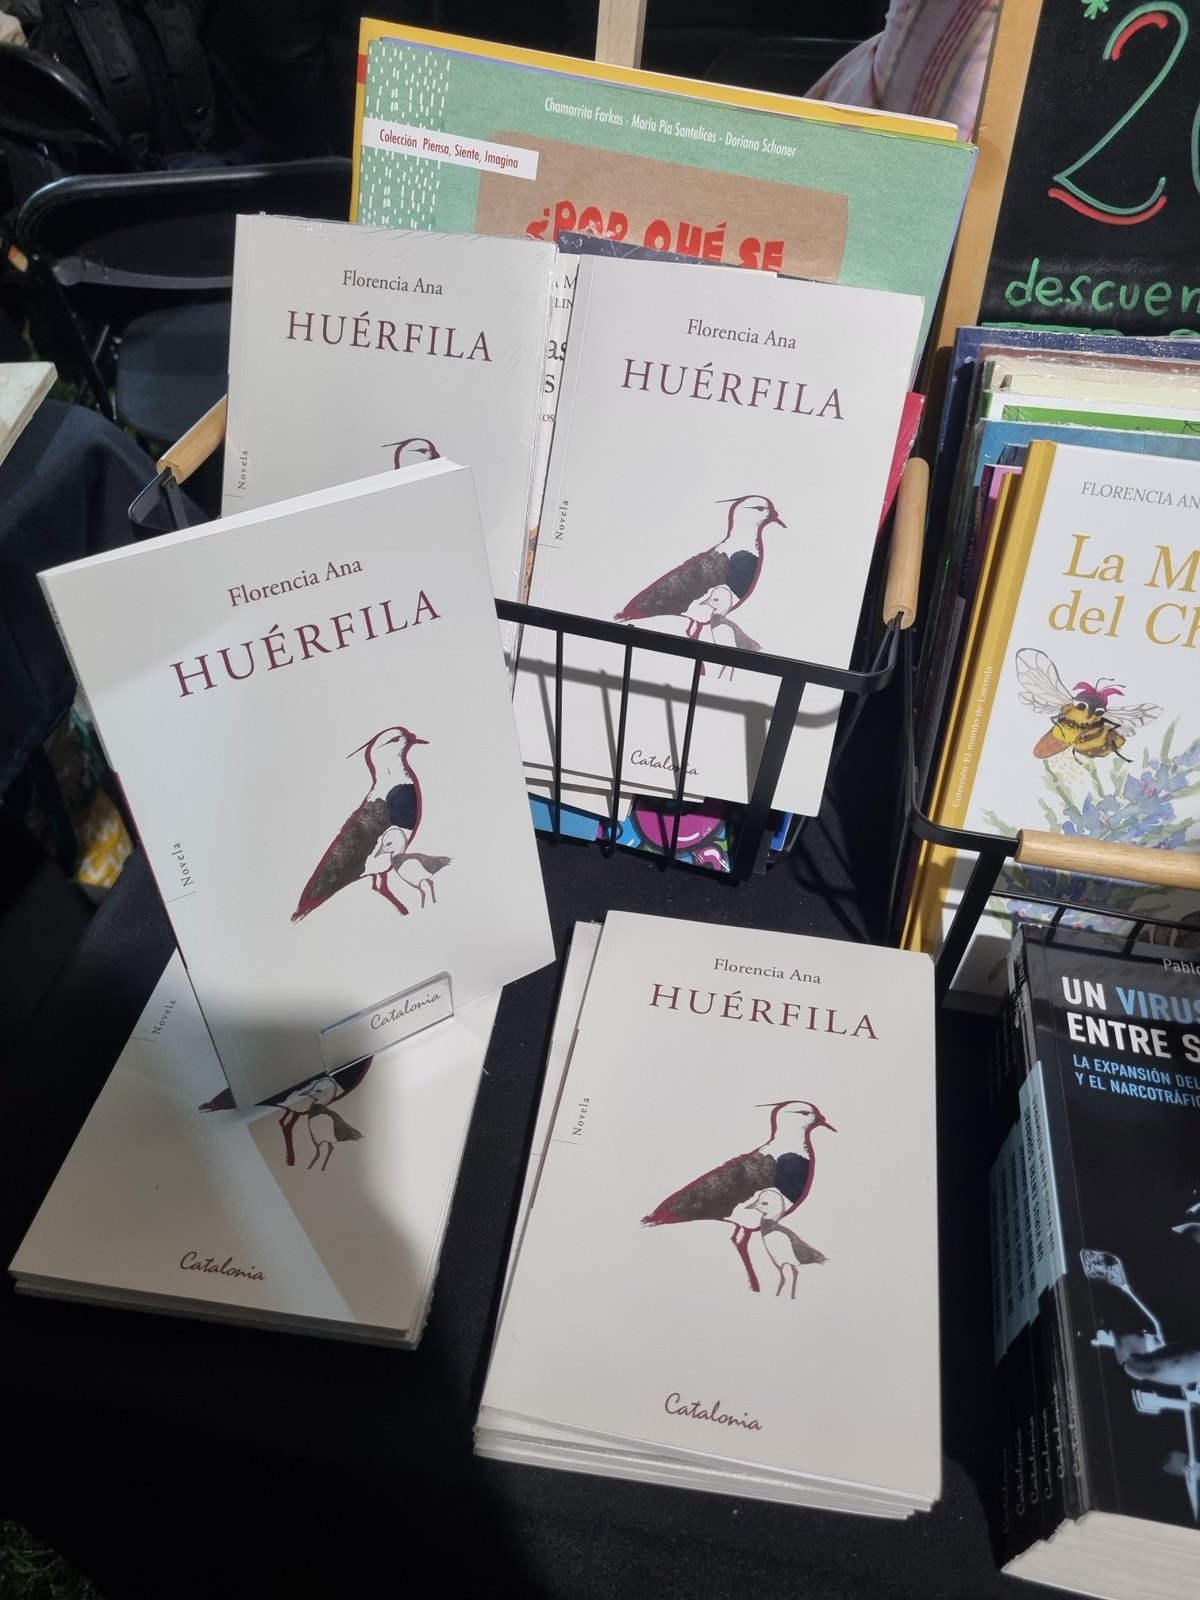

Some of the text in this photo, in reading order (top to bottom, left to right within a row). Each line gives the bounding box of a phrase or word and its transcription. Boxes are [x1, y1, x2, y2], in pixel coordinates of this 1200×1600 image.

[544, 97, 592, 120] Chamarrita
[594, 107, 623, 126] Farkas
[631, 114, 656, 132] María
[674, 124, 717, 144] Santelices
[725, 132, 760, 151] Doriana
[762, 139, 797, 158] Schoner
[1053, 1, 1200, 216] 2
[380, 129, 519, 169] Colección Piensa, Siente, Imagina
[342, 269, 444, 296] Florencia Ana
[286, 310, 493, 363] HUÉRFILA
[686, 318, 797, 351] Florencia Ana
[620, 358, 845, 421] HUÉRFILA
[237, 449, 249, 490] Novela
[1081, 481, 1173, 506] FLORENCIA
[555, 500, 569, 540] Novela
[1062, 534, 1125, 583] La
[227, 560, 363, 607] Florencia Ana
[1048, 589, 1126, 638] del
[169, 589, 442, 698] HUÉRFILA
[952, 664, 994, 808] Colección El mundo de Lucinda
[173, 842, 194, 888] Novela
[713, 958, 821, 985] Florencia Ana
[370, 992, 441, 1031] Catalonia
[649, 982, 880, 1040] HUÉRFILA
[1062, 976, 1107, 1010] UN
[151, 999, 177, 1035] Novela
[1066, 1011, 1172, 1059] ENTRE
[1072, 1054, 1200, 1090] LA EXPANSIÓN DEL
[1075, 1071, 1085, 1086] Y
[1088, 1075, 1106, 1091] EL
[572, 1096, 590, 1137] Novela
[1029, 1161, 1038, 1201] ENTRE
[1033, 1201, 1041, 1241] VIRUS
[179, 1250, 266, 1282] Catalonia
[1037, 1240, 1043, 1262] UN
[664, 1392, 763, 1431] Catalonia
